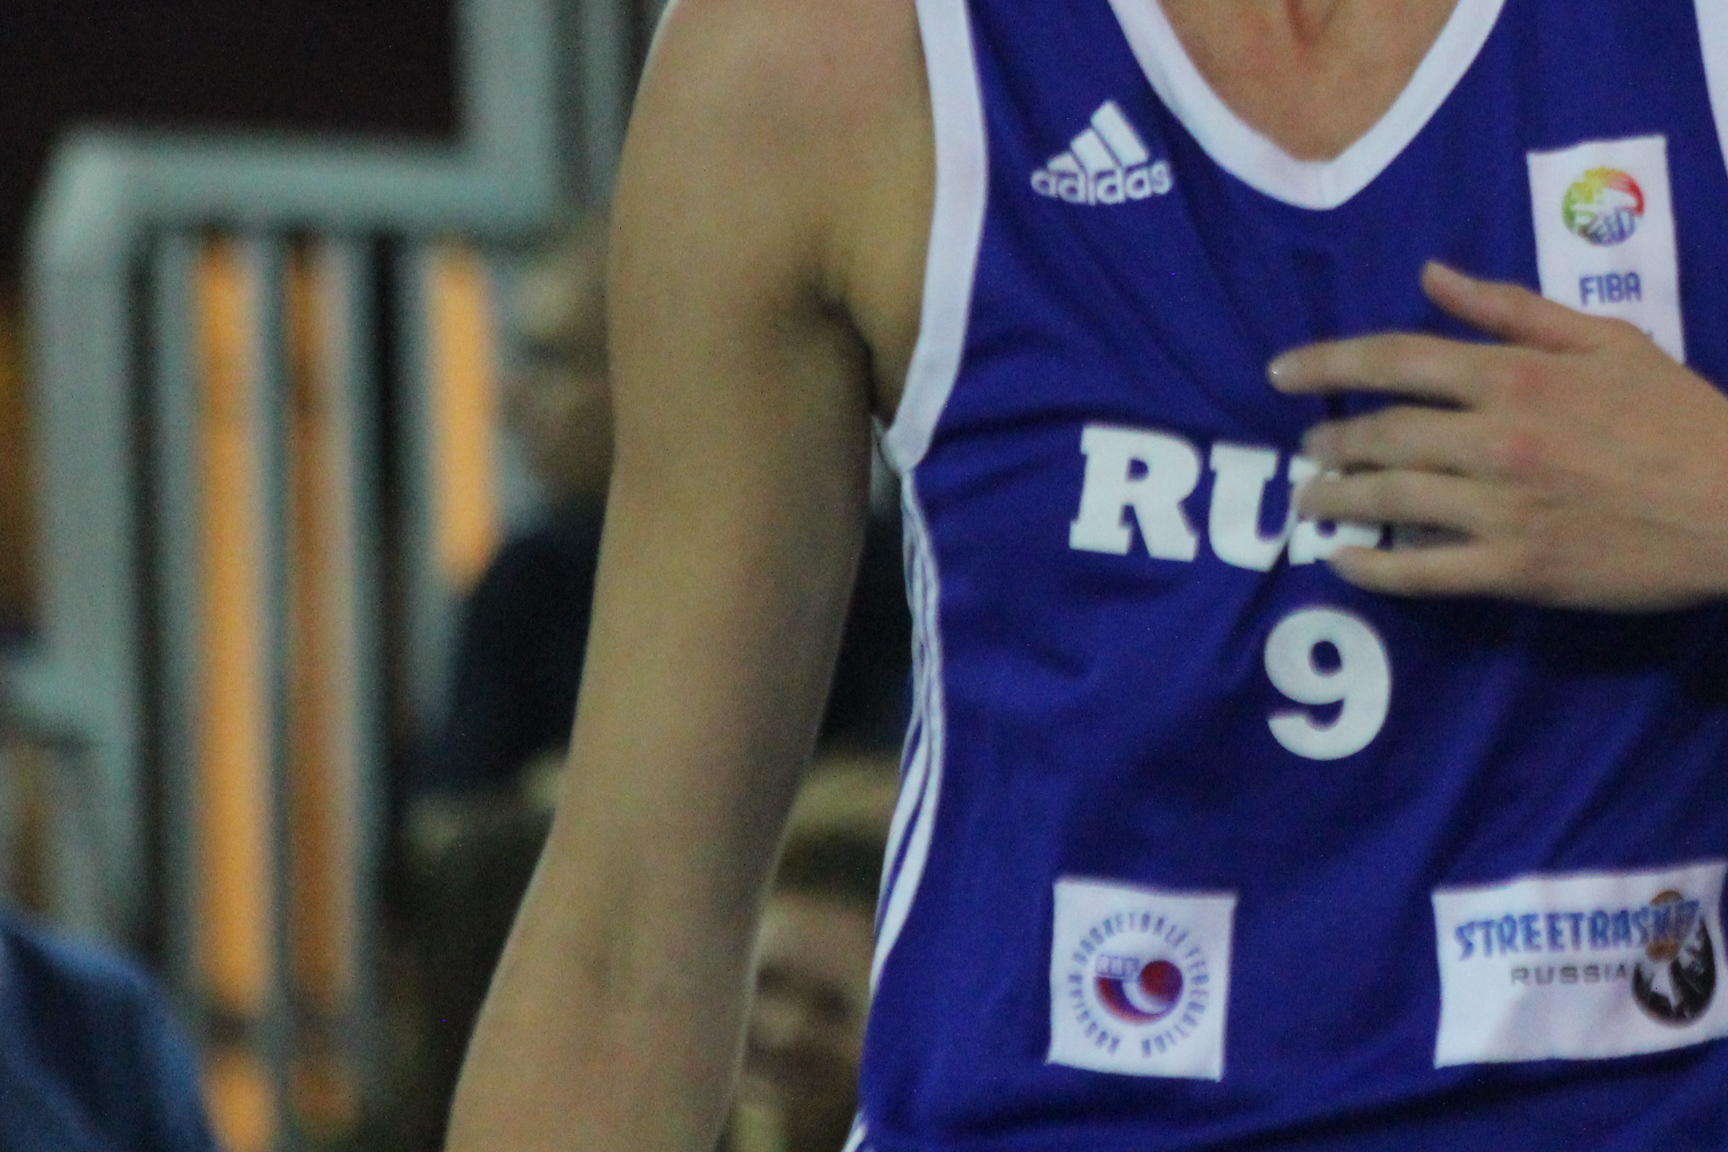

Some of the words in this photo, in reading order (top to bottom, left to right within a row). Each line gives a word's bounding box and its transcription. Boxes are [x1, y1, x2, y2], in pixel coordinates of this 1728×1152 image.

[1030, 160, 1173, 206] adidas
[1578, 272, 1642, 307] FIBA
[1263, 606, 1391, 761] 9
[1510, 962, 1629, 987] RUSSIA
